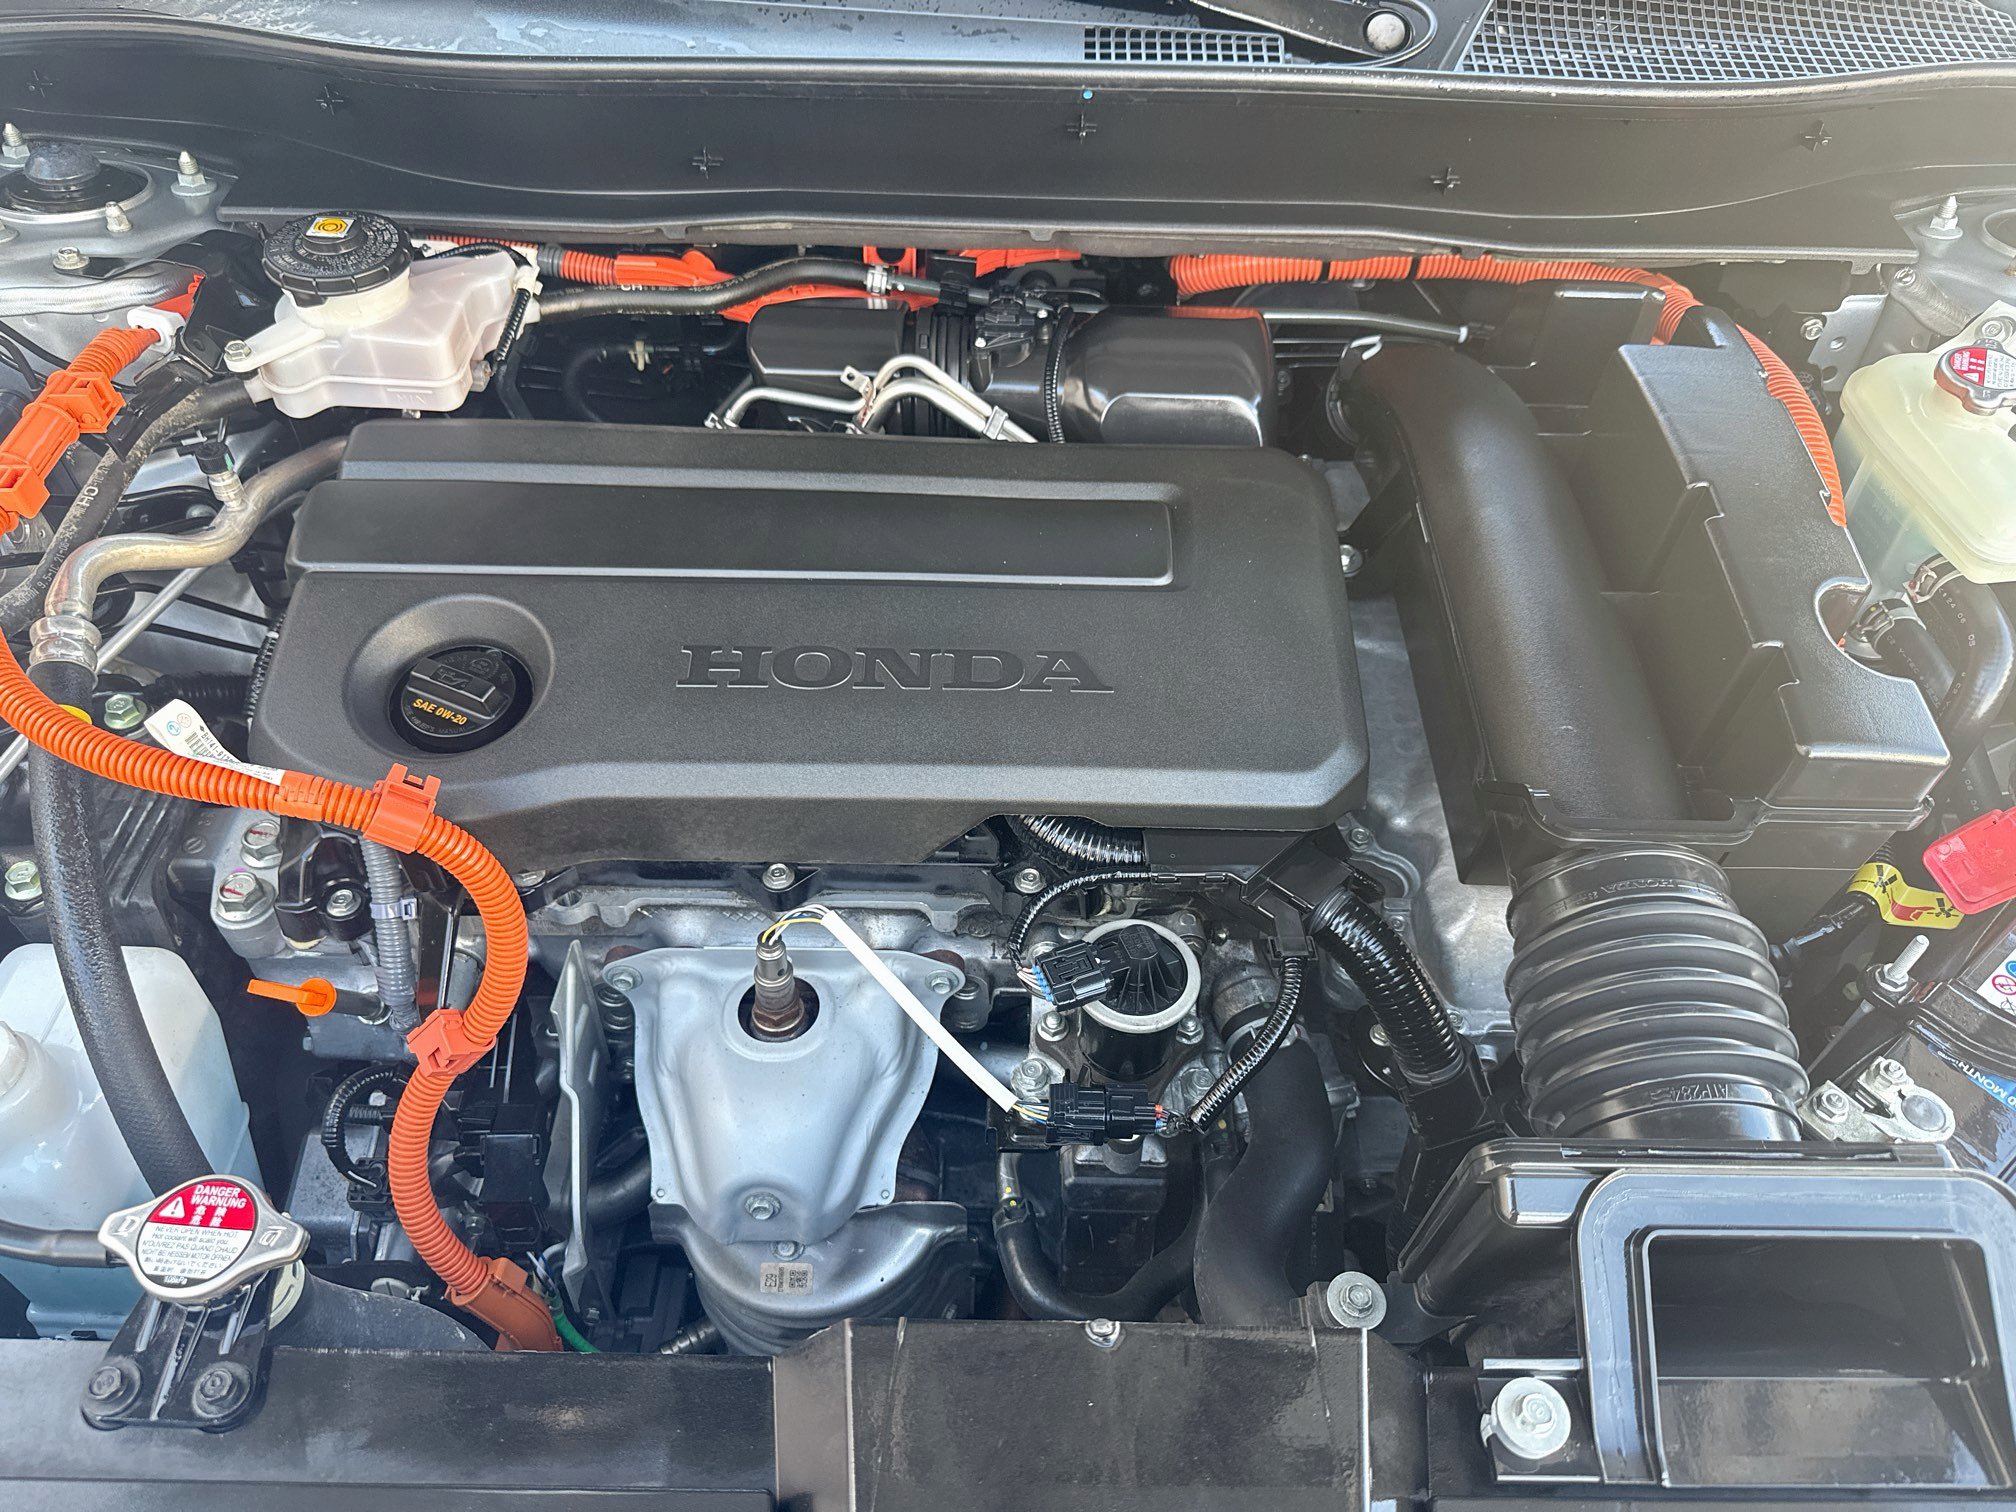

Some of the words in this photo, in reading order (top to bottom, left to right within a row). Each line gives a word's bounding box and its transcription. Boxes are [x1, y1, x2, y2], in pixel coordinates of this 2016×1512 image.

[676, 645, 1114, 693] HONDA
[413, 698, 438, 713] SAE
[435, 707, 468, 725] 0W-20
[1958, 1061, 2008, 1099] MONTH
[194, 1184, 241, 1198] DANGER
[190, 1195, 247, 1208] WARNUNG
[155, 1225, 178, 1233] NEVER
[181, 1227, 200, 1235] OPEN
[201, 1229, 222, 1237] WHEN
[765, 1273, 778, 1288] E29
